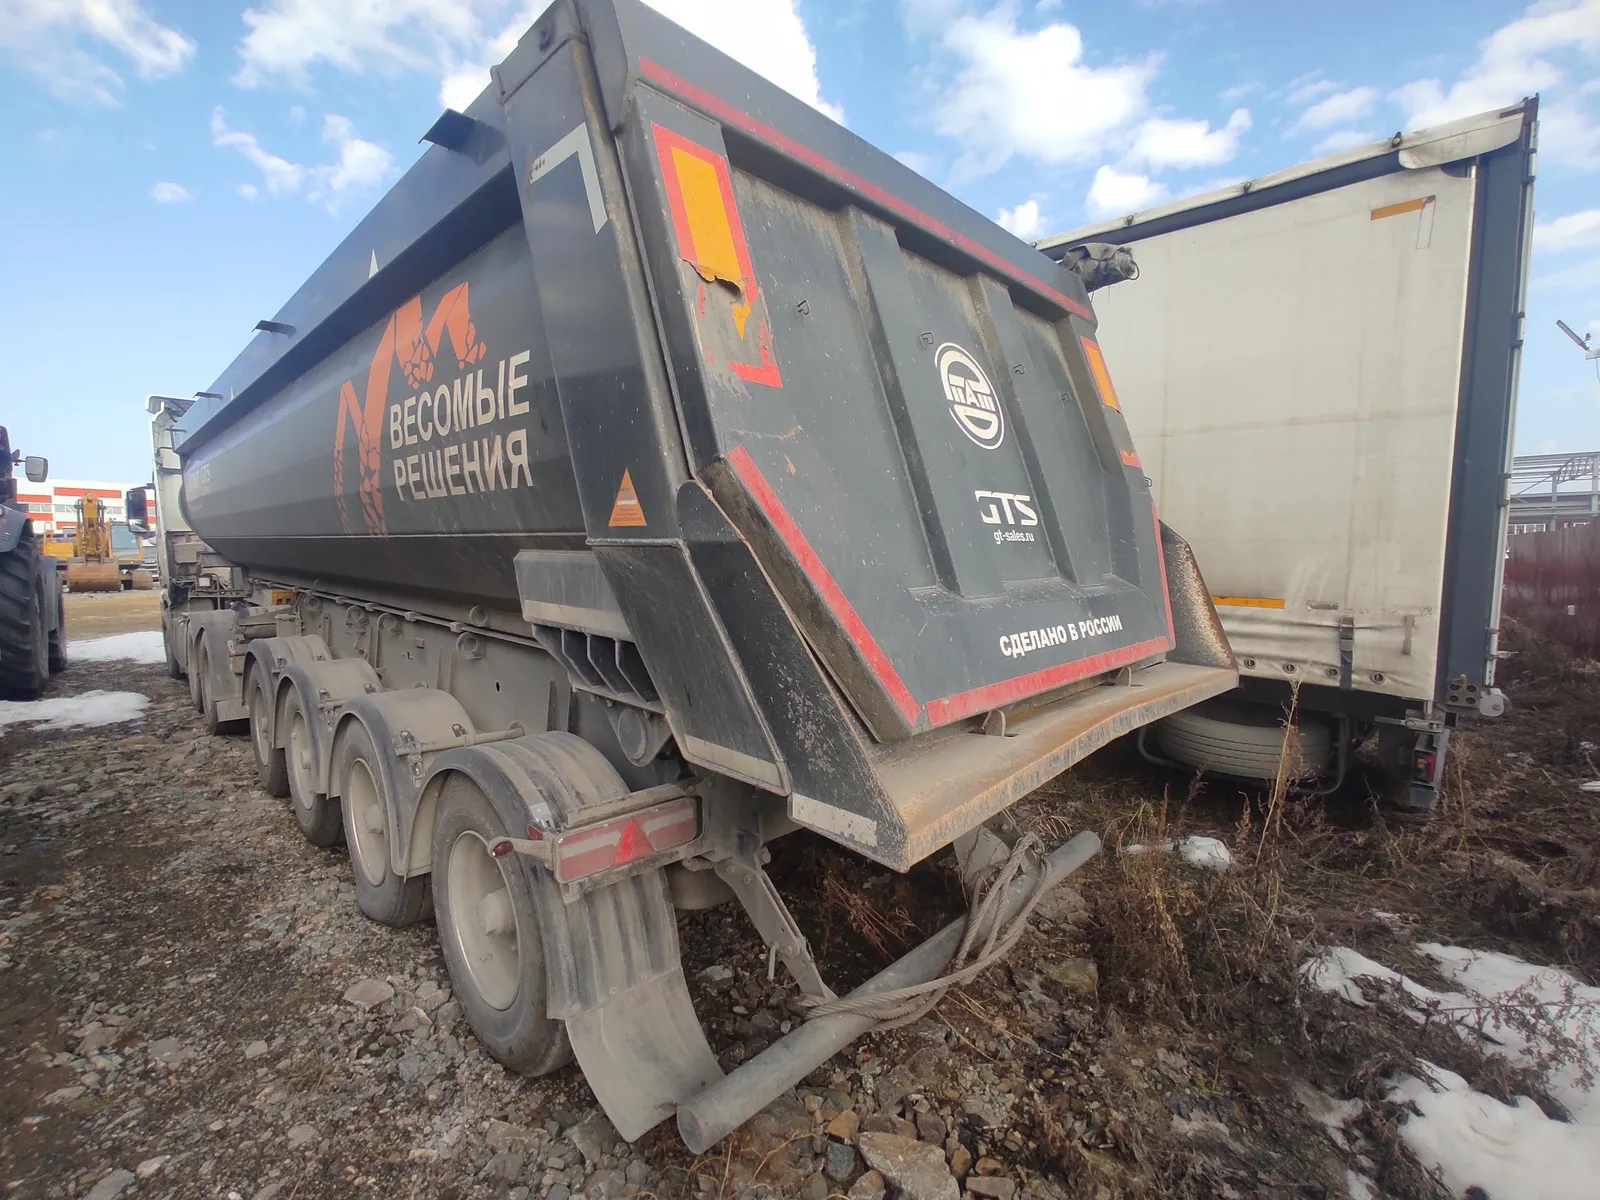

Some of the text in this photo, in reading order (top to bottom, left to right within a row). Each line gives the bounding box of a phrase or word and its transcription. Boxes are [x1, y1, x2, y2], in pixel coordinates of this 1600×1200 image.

[390, 350, 530, 449] ВЕСОМЫЕ
[393, 428, 534, 501] РЕШЕНИЯ
[974, 490, 1038, 526] GTS
[993, 529, 1035, 545] gt-sales.ru
[999, 614, 1123, 658] СДЕЛАНО В РОССИИ
